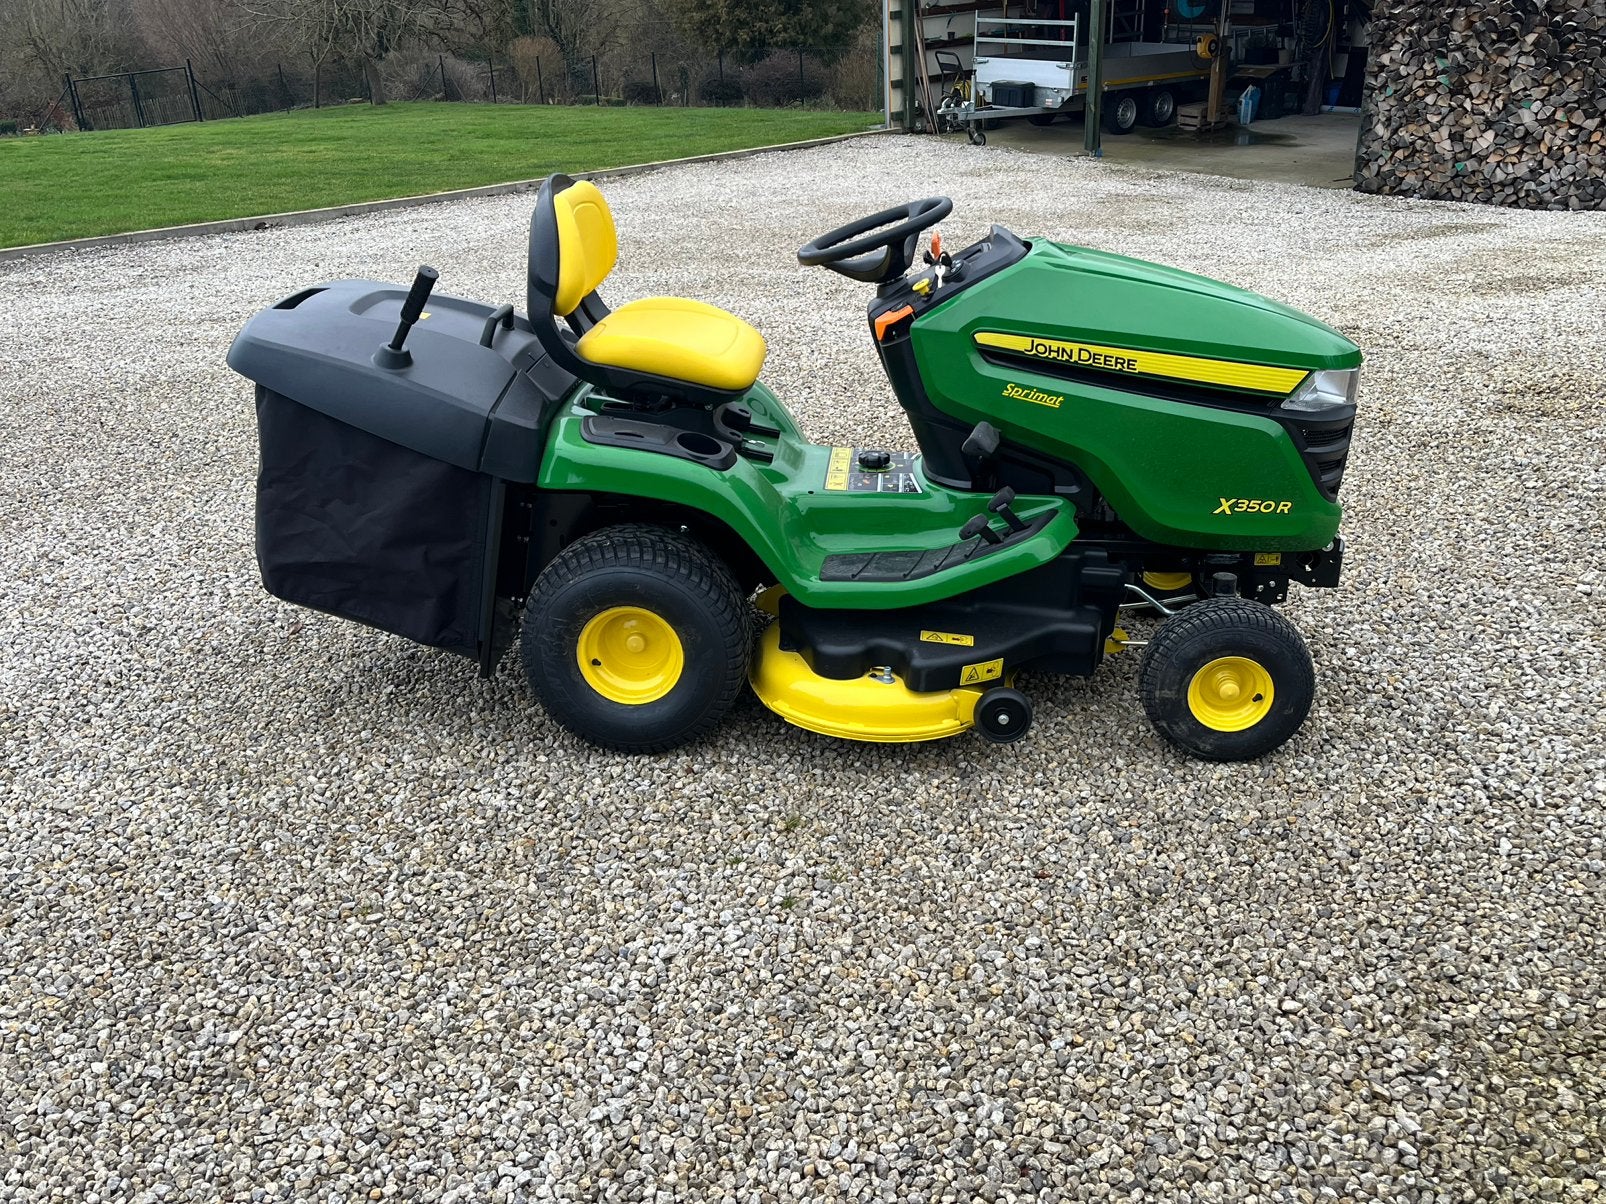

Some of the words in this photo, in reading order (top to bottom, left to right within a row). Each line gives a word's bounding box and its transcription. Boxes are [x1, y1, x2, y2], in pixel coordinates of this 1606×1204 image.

[1024, 339, 1073, 361] JOHN
[1077, 348, 1138, 372] DEERE
[1002, 383, 1064, 408] Sprimat
